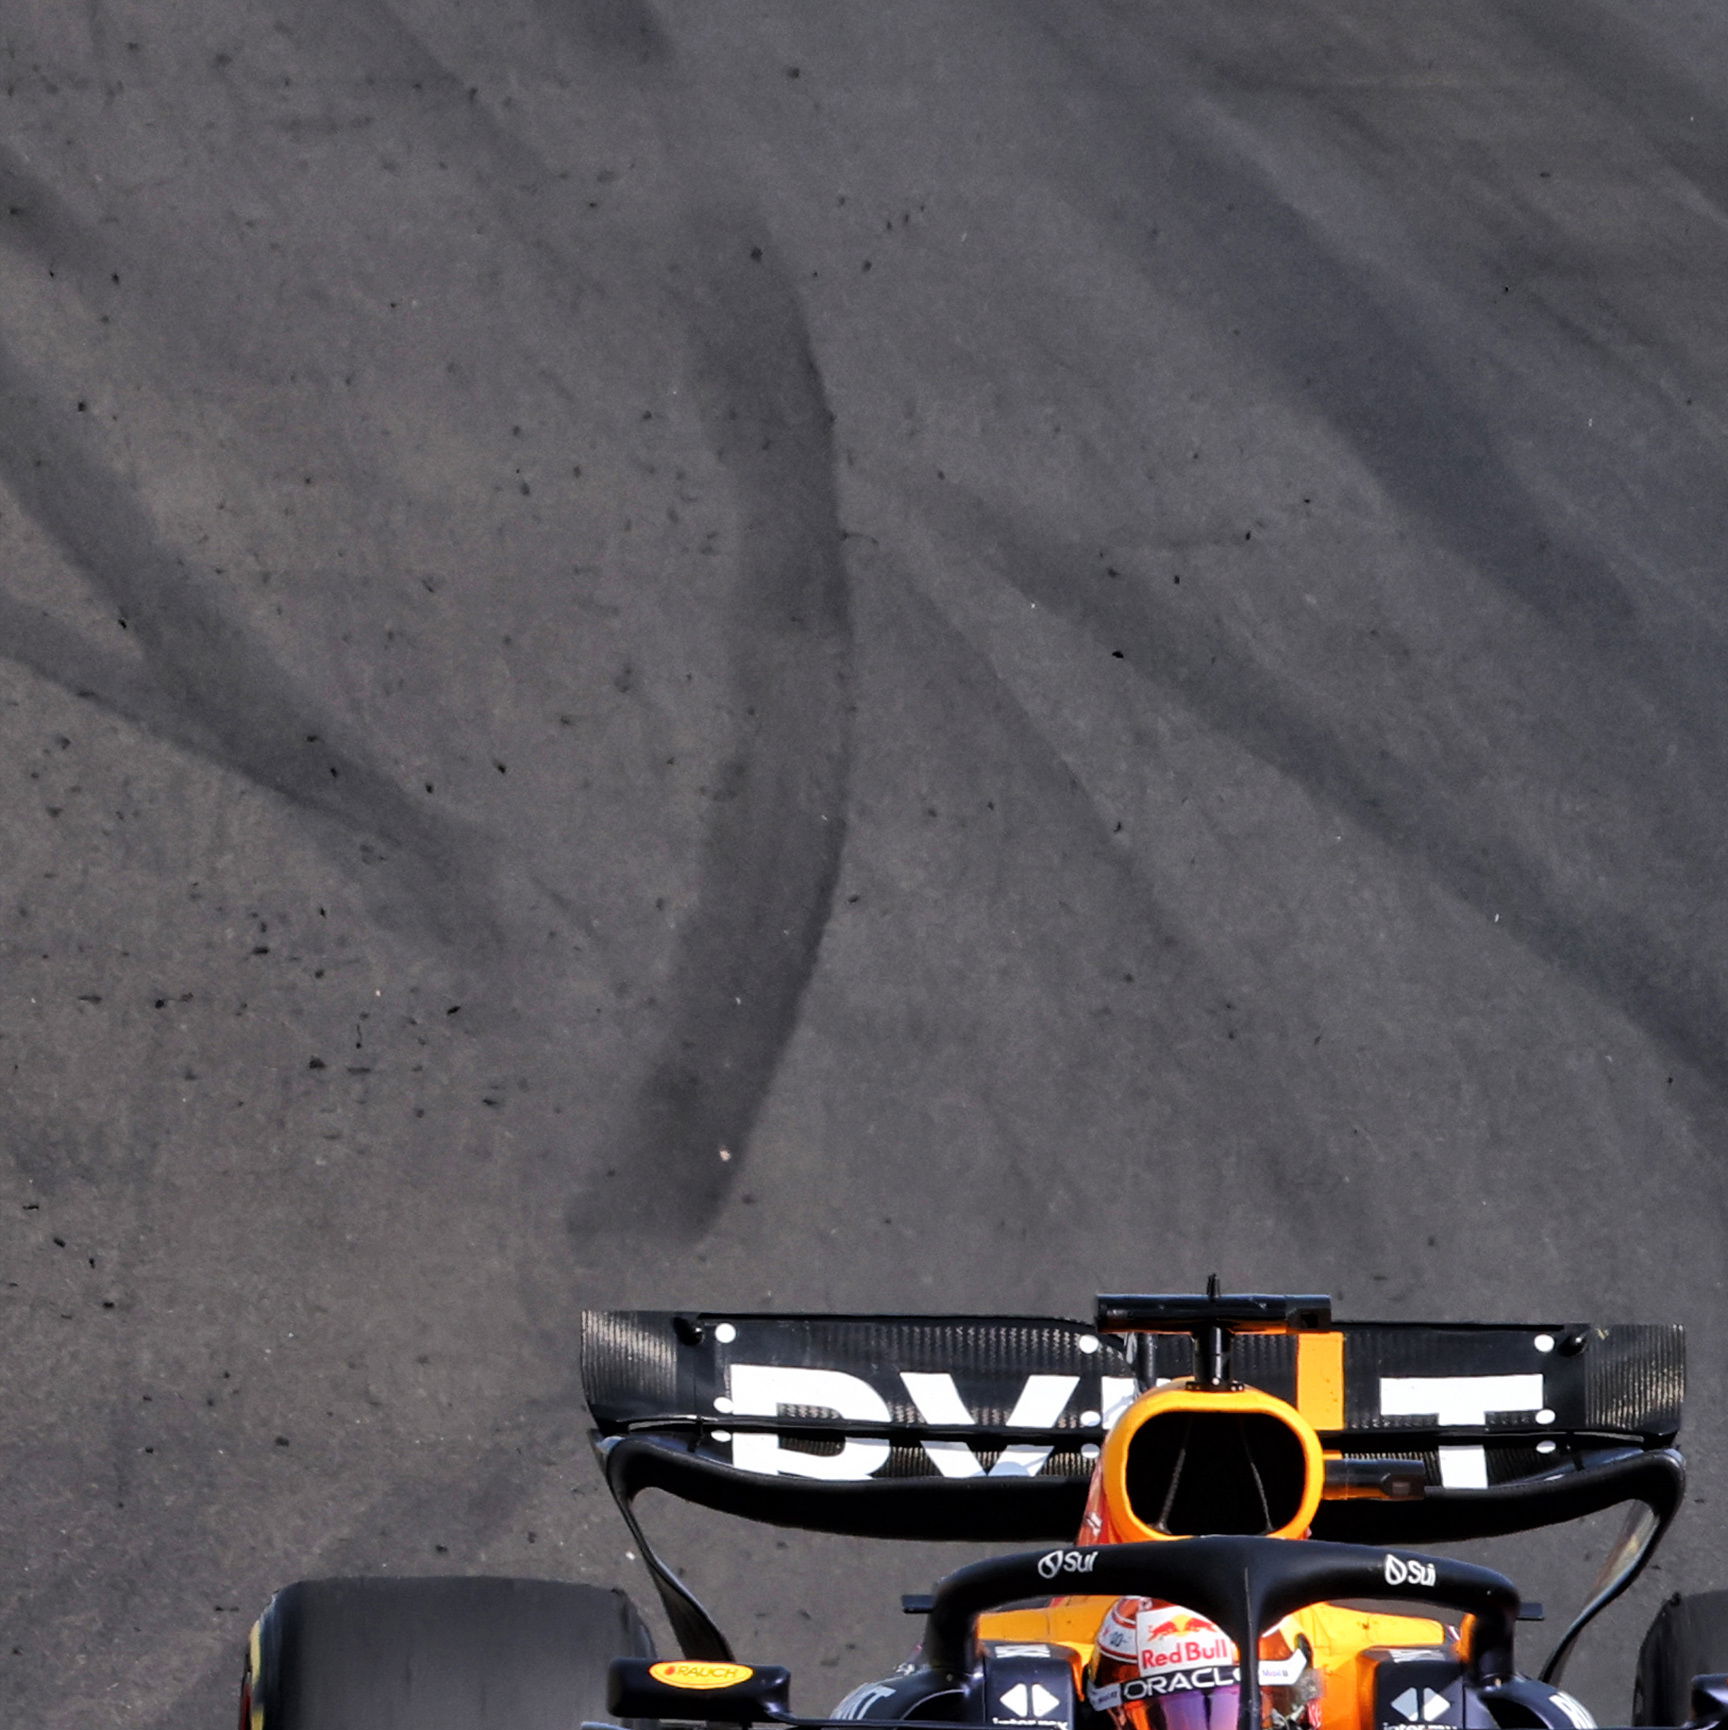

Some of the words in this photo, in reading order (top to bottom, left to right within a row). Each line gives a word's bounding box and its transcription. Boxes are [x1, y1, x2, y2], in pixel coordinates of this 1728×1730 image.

[1408, 1560, 1436, 1586] Sui
[1141, 1640, 1183, 1671] Red
[1186, 1638, 1229, 1665] Bull
[678, 1665, 738, 1679] RAUCH
